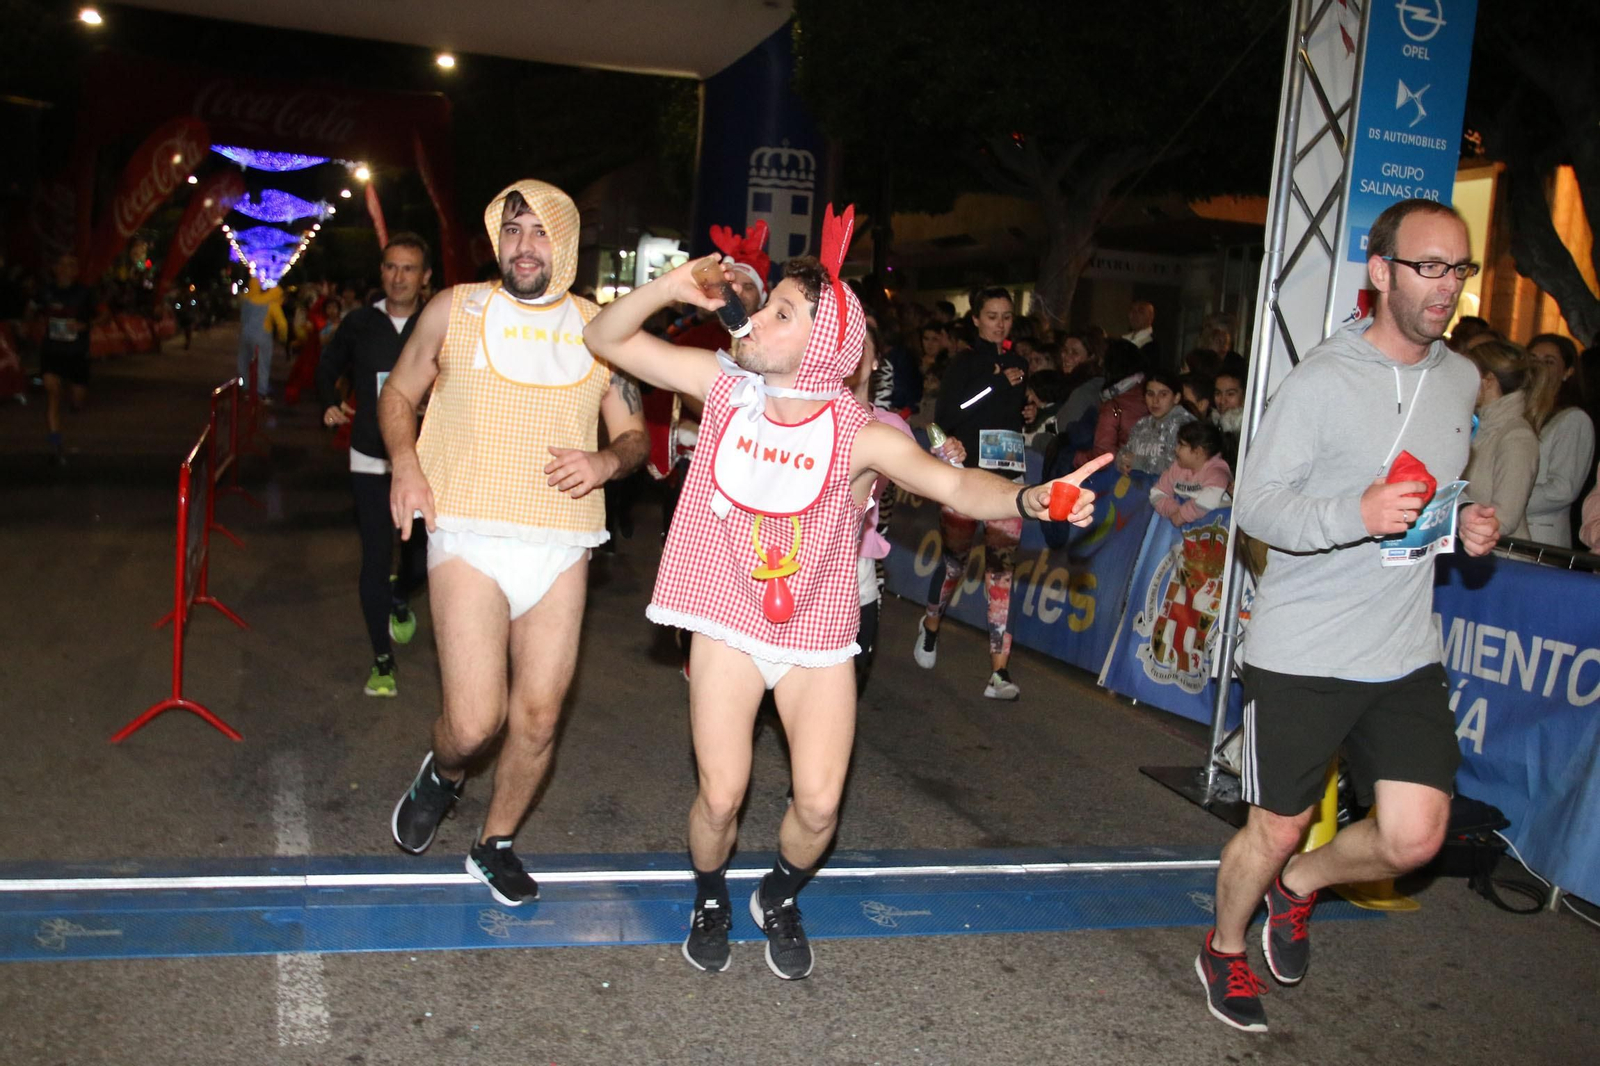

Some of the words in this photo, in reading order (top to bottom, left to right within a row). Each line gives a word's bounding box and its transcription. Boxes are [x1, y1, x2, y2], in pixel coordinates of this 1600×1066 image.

[1402, 43, 1431, 61] OPEL
[1368, 127, 1381, 140] DS
[1383, 130, 1447, 151] AUTOMOBILES
[1381, 162, 1425, 182] GRUPO
[1360, 179, 1412, 199] SALINAS
[1414, 187, 1440, 203] CAR
